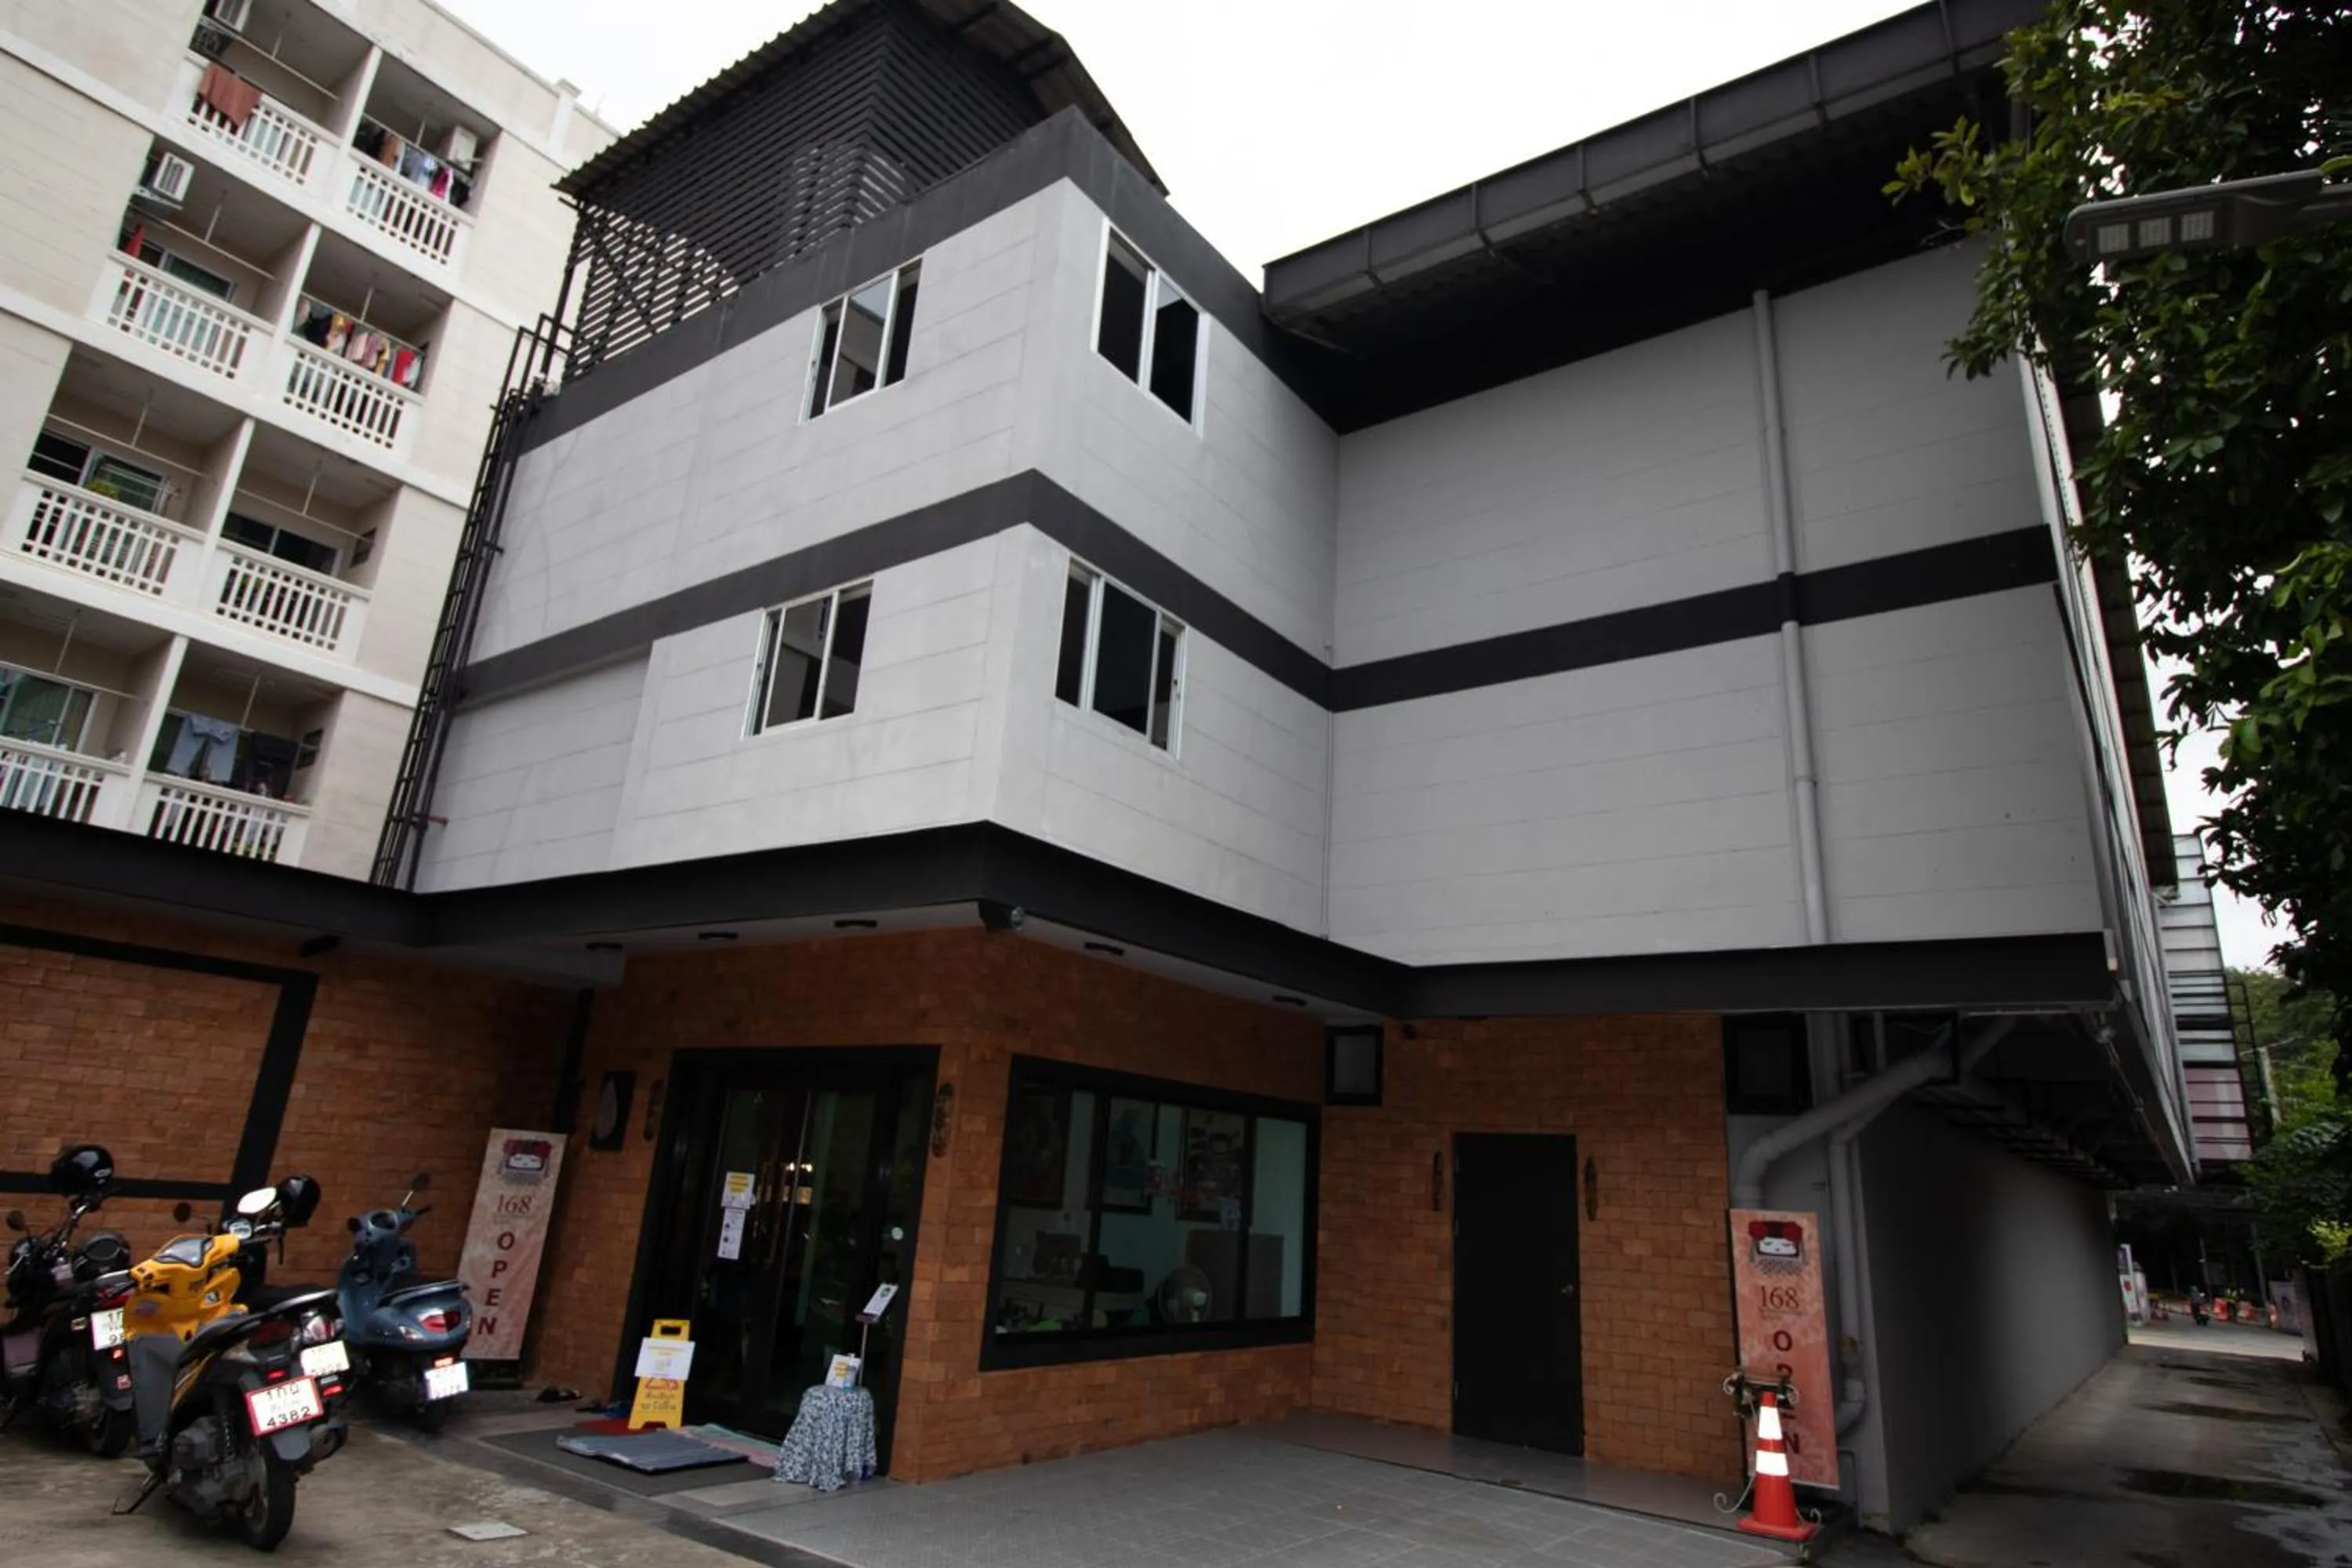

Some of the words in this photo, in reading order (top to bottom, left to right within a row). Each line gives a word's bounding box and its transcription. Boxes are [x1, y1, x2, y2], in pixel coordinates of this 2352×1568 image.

[496, 1193, 533, 1215] 168
[477, 1232, 515, 1335] OPEN
[1760, 1285, 1800, 1310] 168
[267, 1406, 310, 1427] 4382
